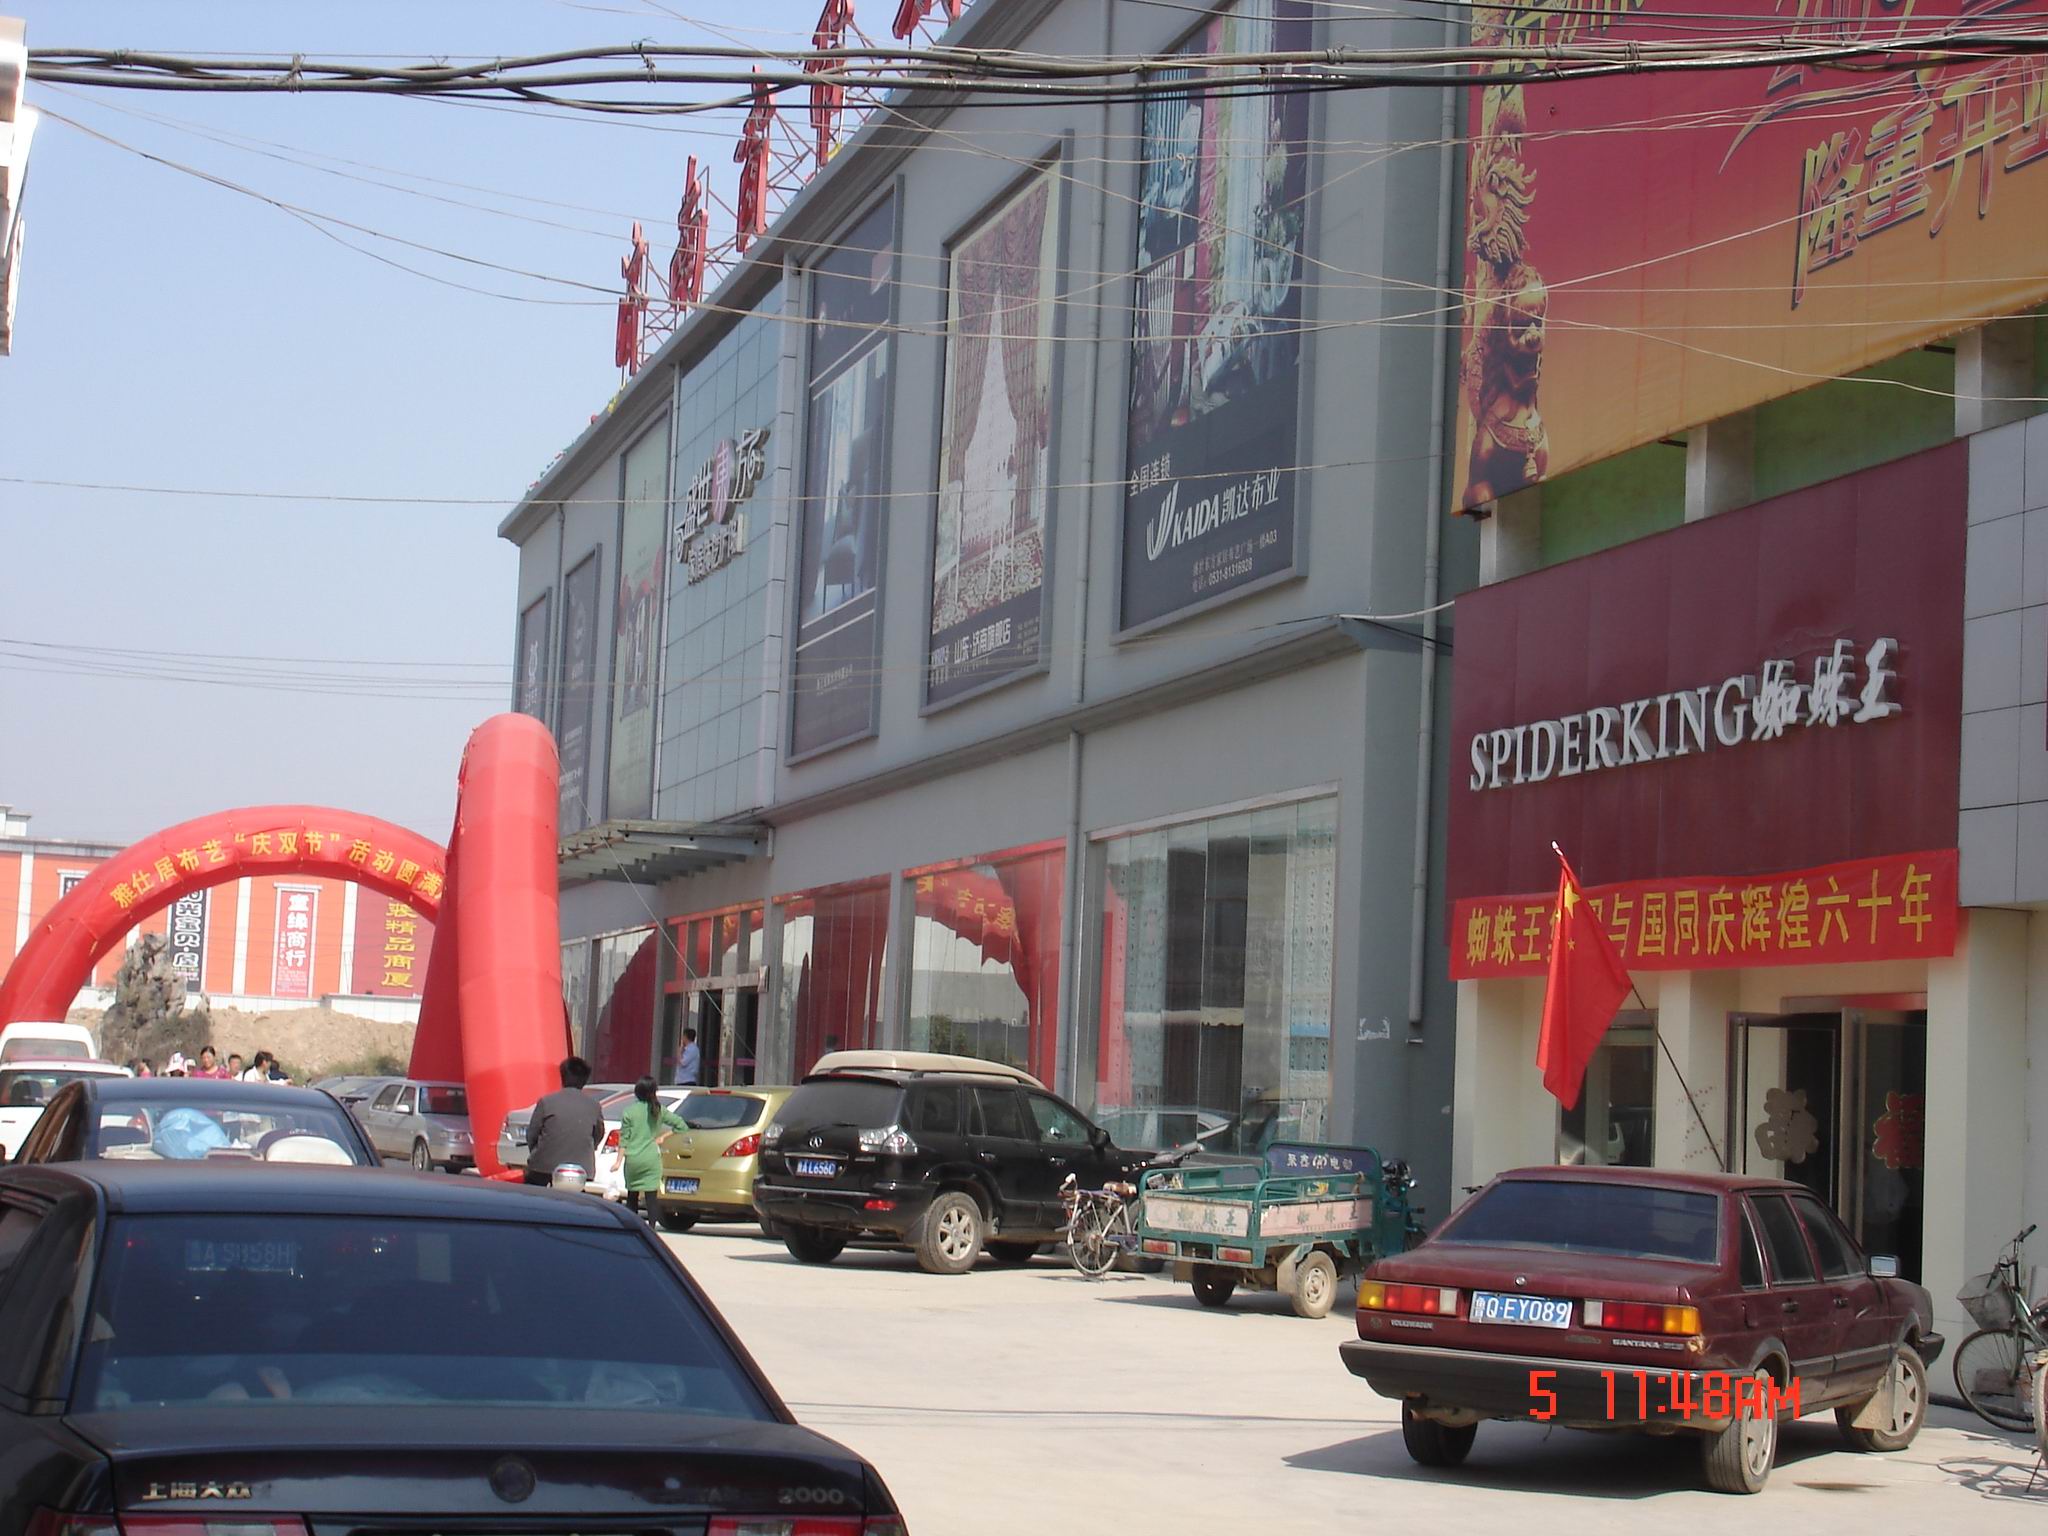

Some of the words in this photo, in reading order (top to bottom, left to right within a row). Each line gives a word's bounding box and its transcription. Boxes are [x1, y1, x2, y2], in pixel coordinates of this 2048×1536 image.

[1129, 452, 1171, 497] 全国连锁
[1171, 493, 1219, 548] KAIDA
[1220, 466, 1281, 525] 凯达布业
[1470, 676, 1752, 792] SPIDERKING
[109, 831, 443, 909] 雅仕居布艺“庆双节”活动圆满
[1466, 863, 1933, 967] 蜘蛛王与国同庆辉煌六十年
[142, 1481, 252, 1500] 上海大众
[777, 1486, 844, 1505] 2000
